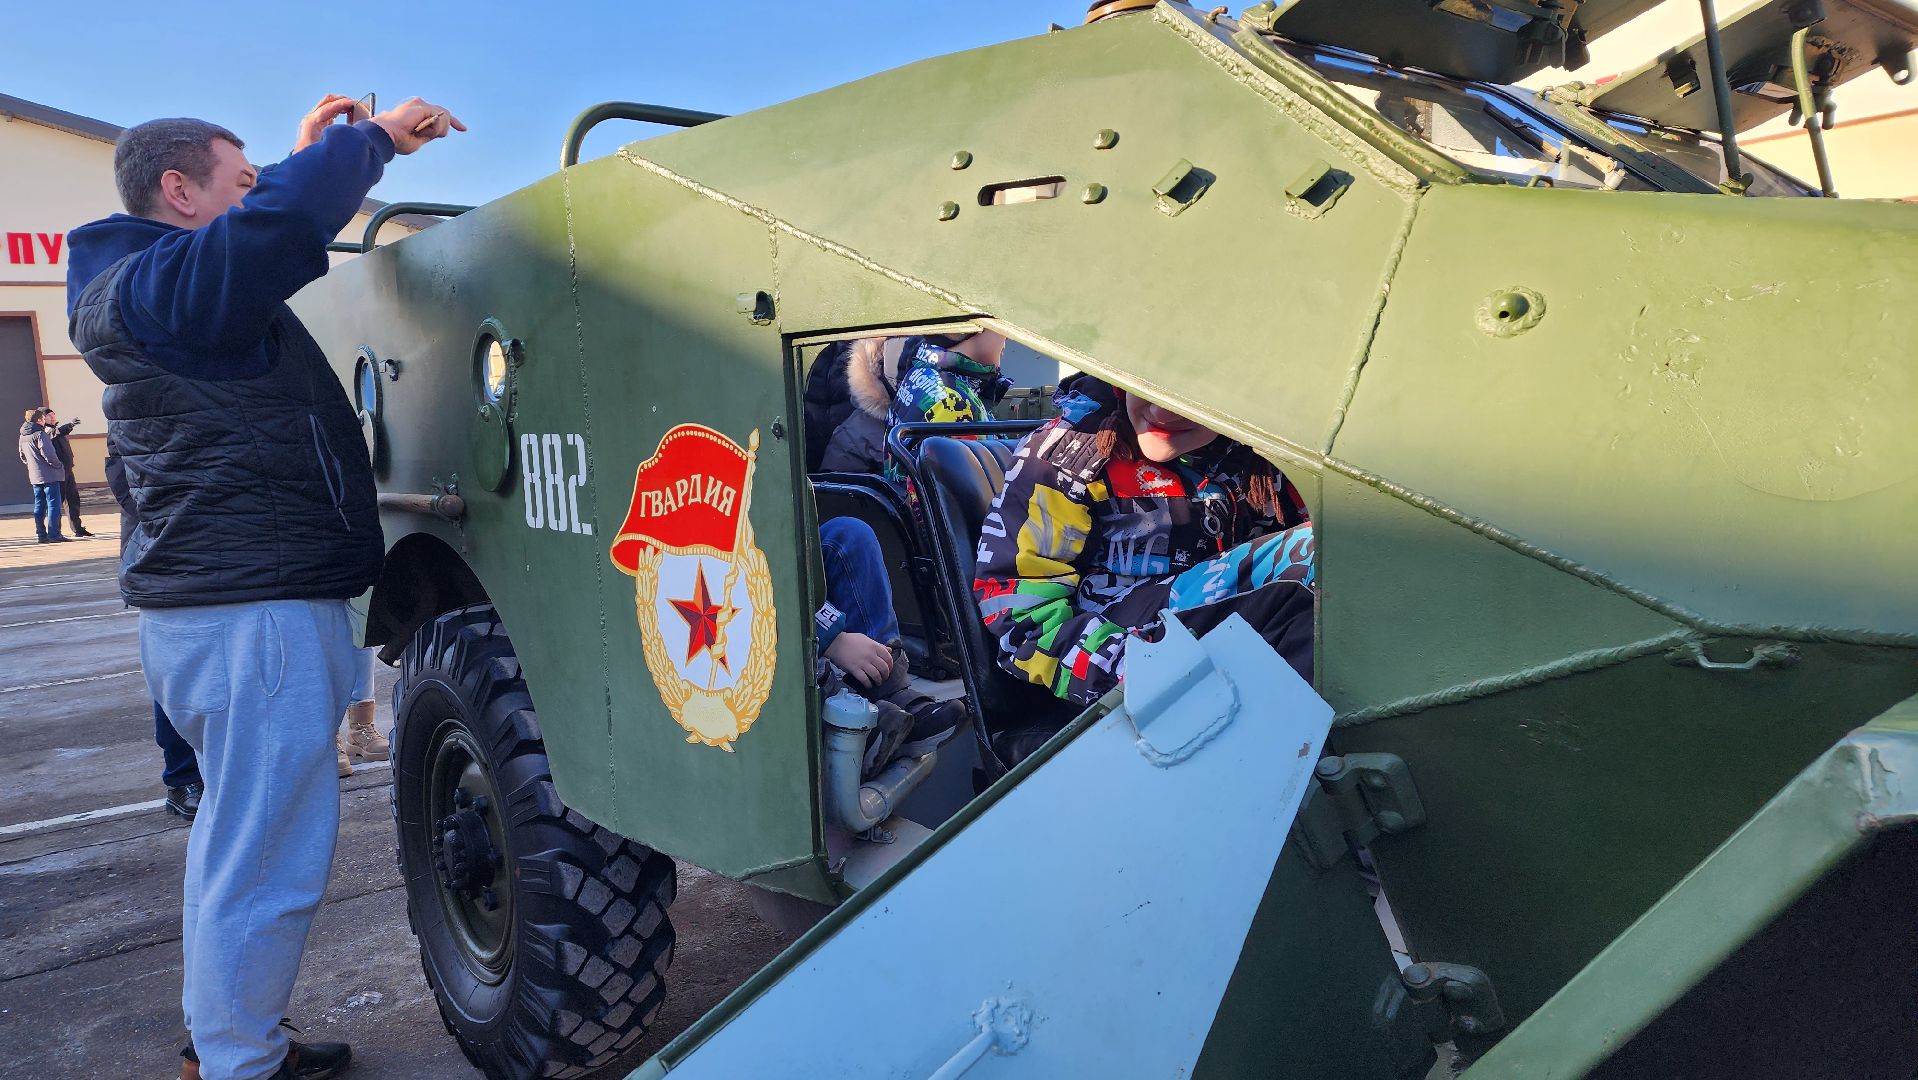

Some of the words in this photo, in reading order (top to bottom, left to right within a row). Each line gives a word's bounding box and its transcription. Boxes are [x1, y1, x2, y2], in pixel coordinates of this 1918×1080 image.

[0, 232, 64, 264] ПУ
[520, 433, 592, 535] 882
[640, 473, 736, 517] ГВАРДИЯ
